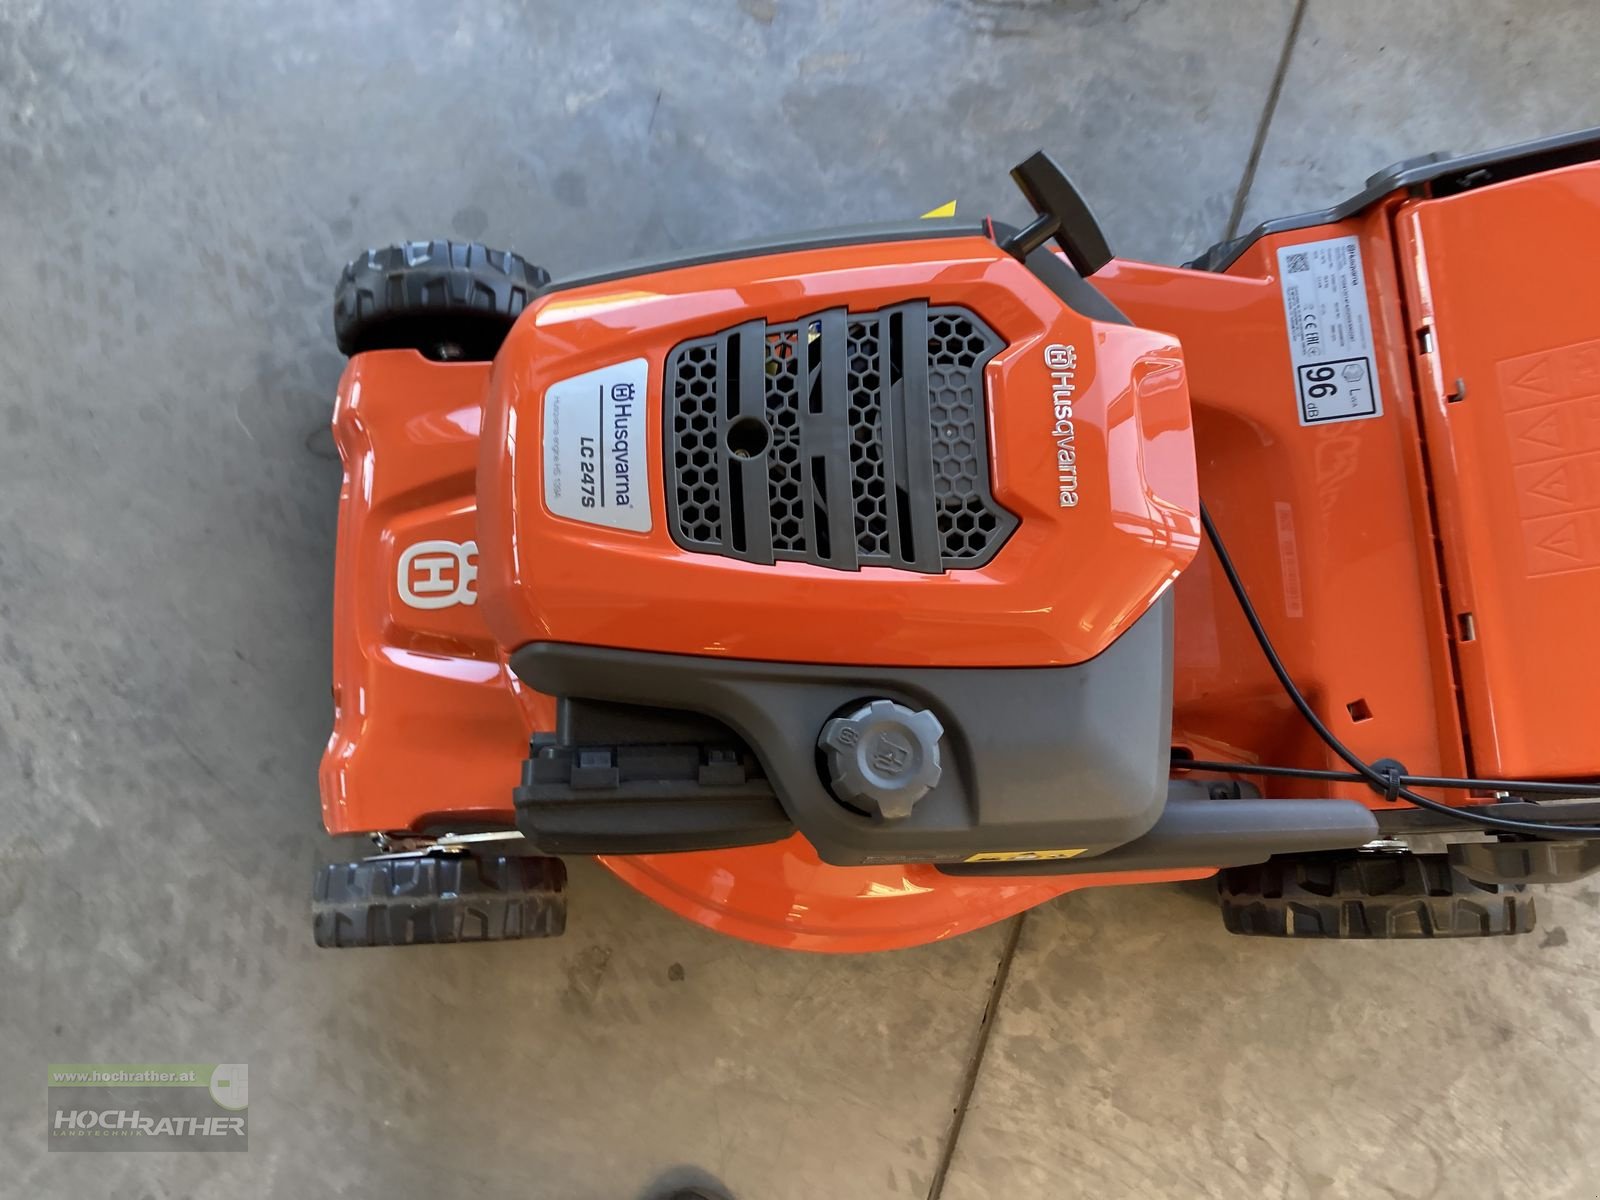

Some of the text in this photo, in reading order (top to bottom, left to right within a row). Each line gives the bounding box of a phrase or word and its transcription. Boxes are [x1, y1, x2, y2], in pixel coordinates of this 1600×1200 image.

[553, 396, 561, 436] Husqvarna
[1306, 366, 1337, 418] 96 dB
[552, 437, 560, 462] engine
[612, 404, 632, 506] Husqvarna
[1051, 372, 1079, 508] Husqvarna
[580, 436, 595, 508] LC 247S
